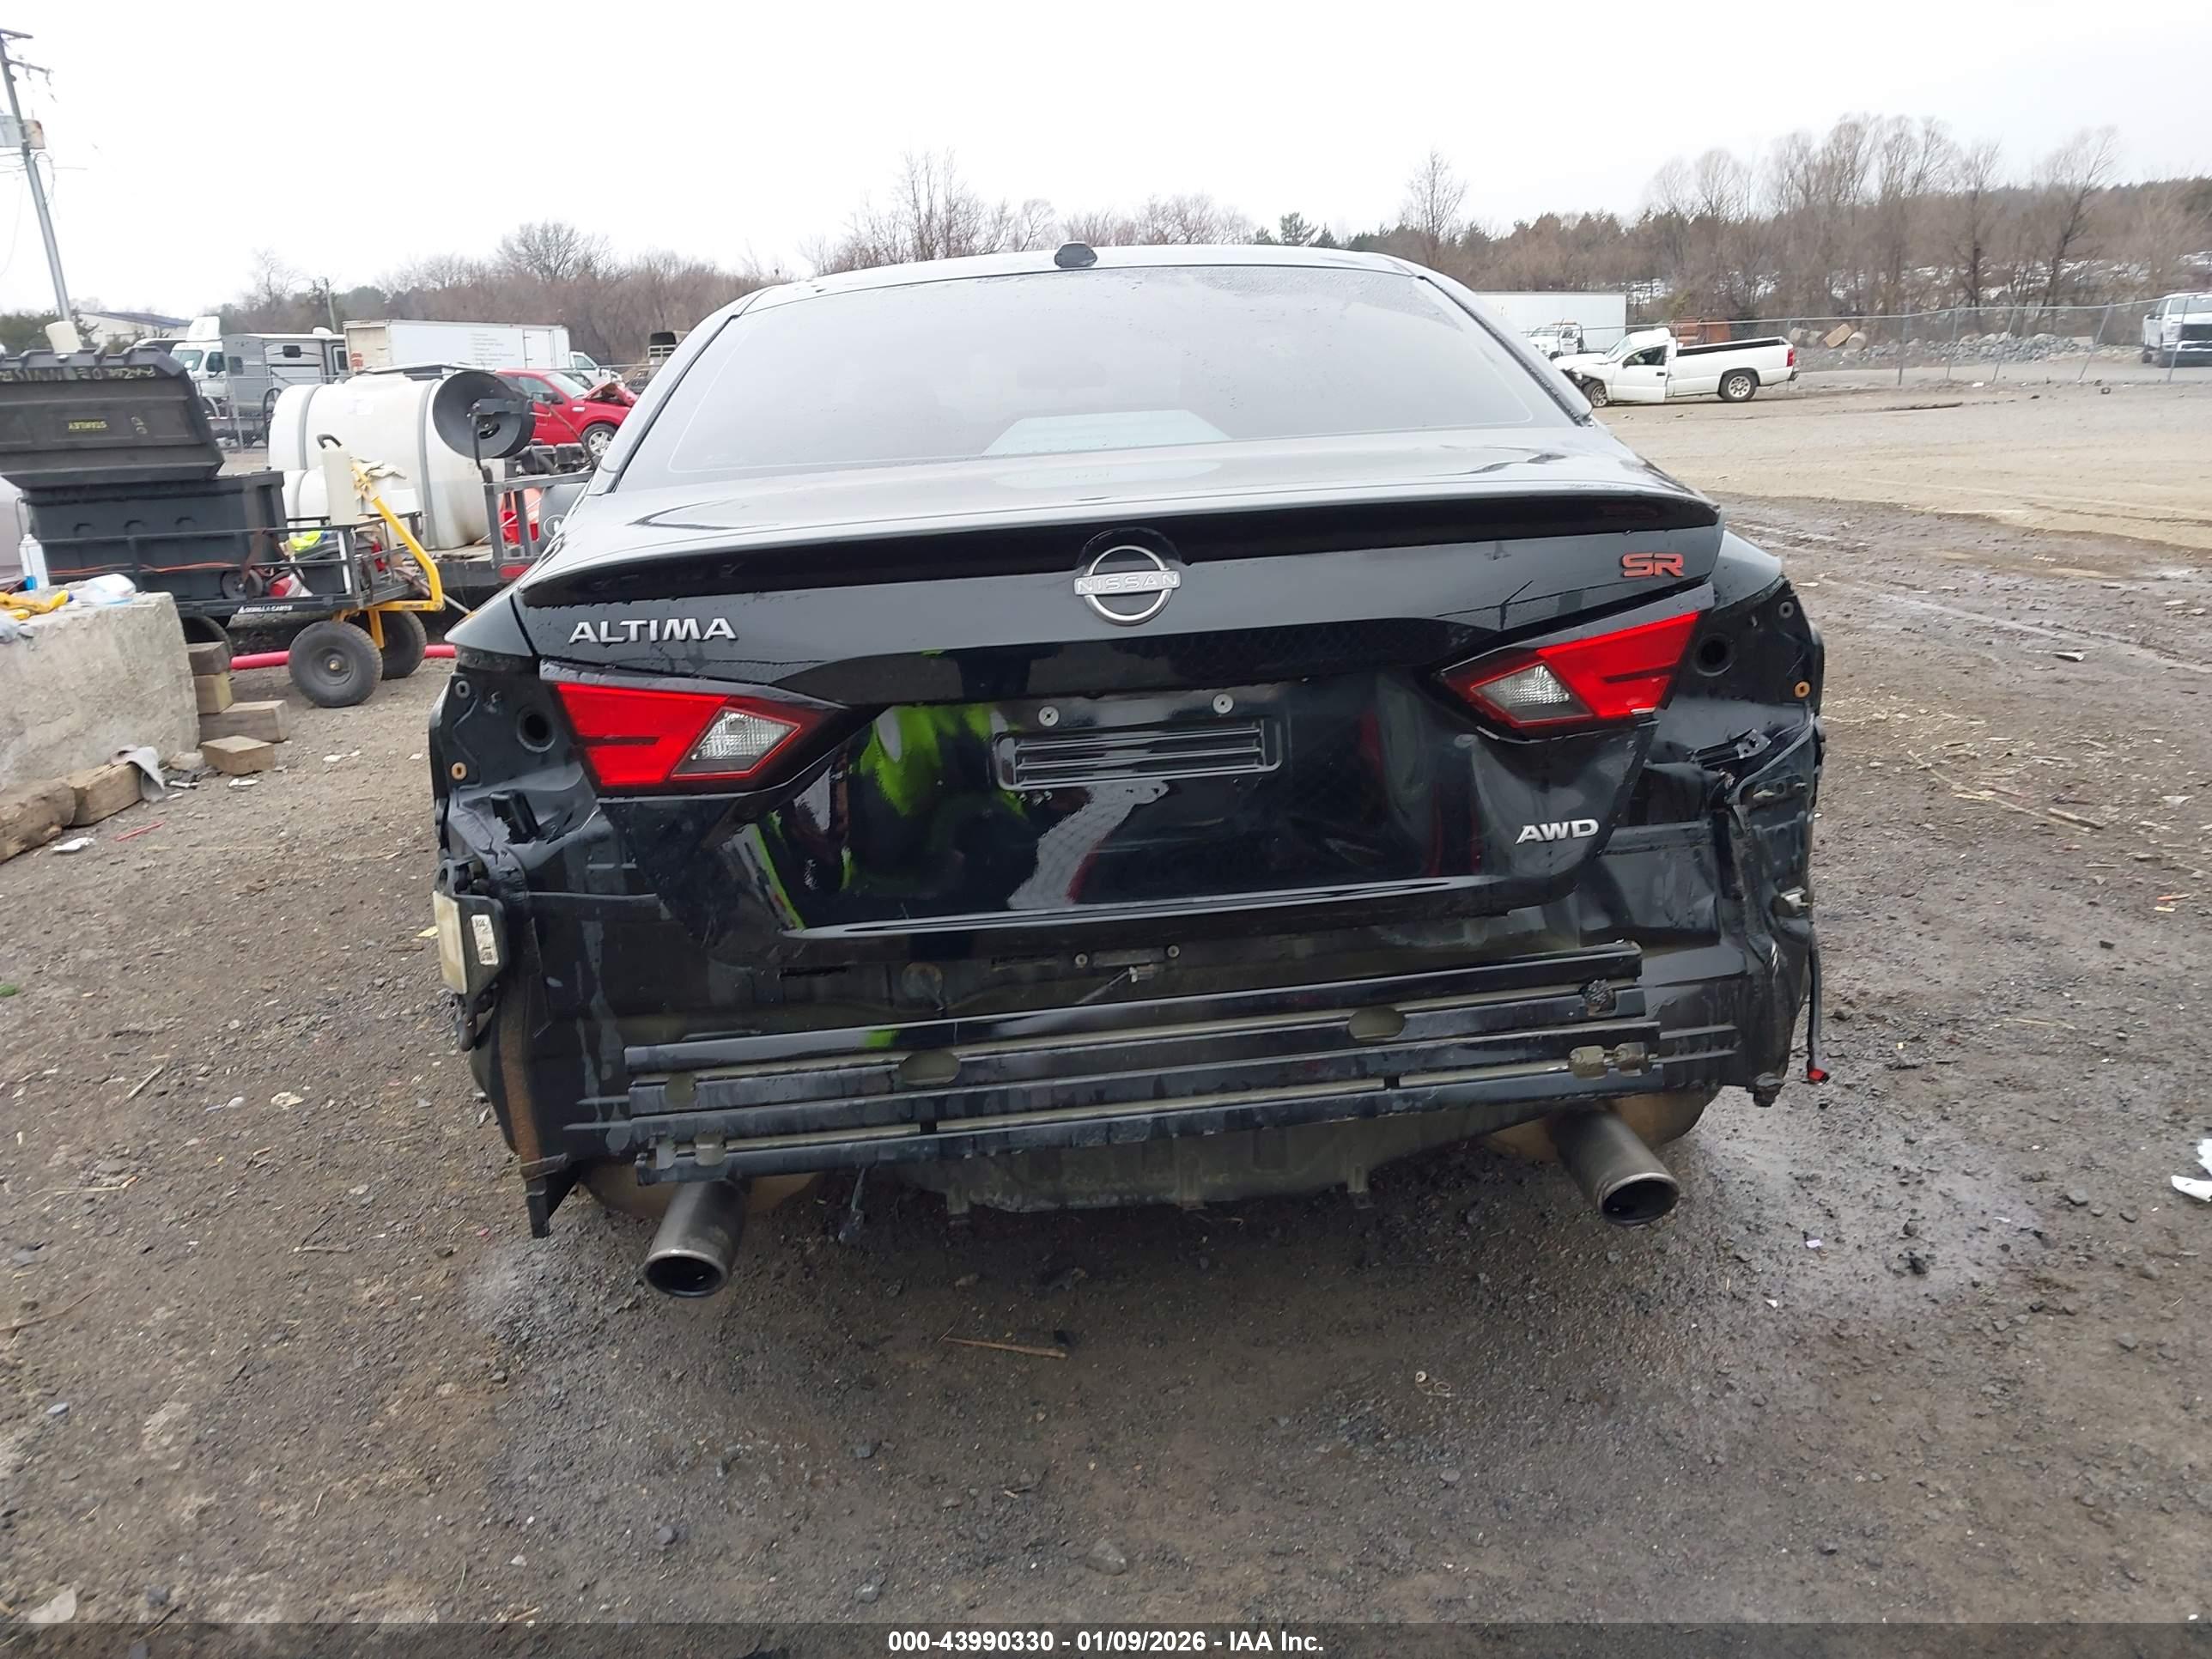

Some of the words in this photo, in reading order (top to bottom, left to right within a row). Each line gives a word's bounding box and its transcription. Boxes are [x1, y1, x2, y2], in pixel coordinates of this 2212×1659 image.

[1621, 552, 1685, 578] SR
[1077, 572, 1178, 592] NISSAN
[568, 617, 738, 644] ALTIMA
[1514, 818, 1600, 845] AWD
